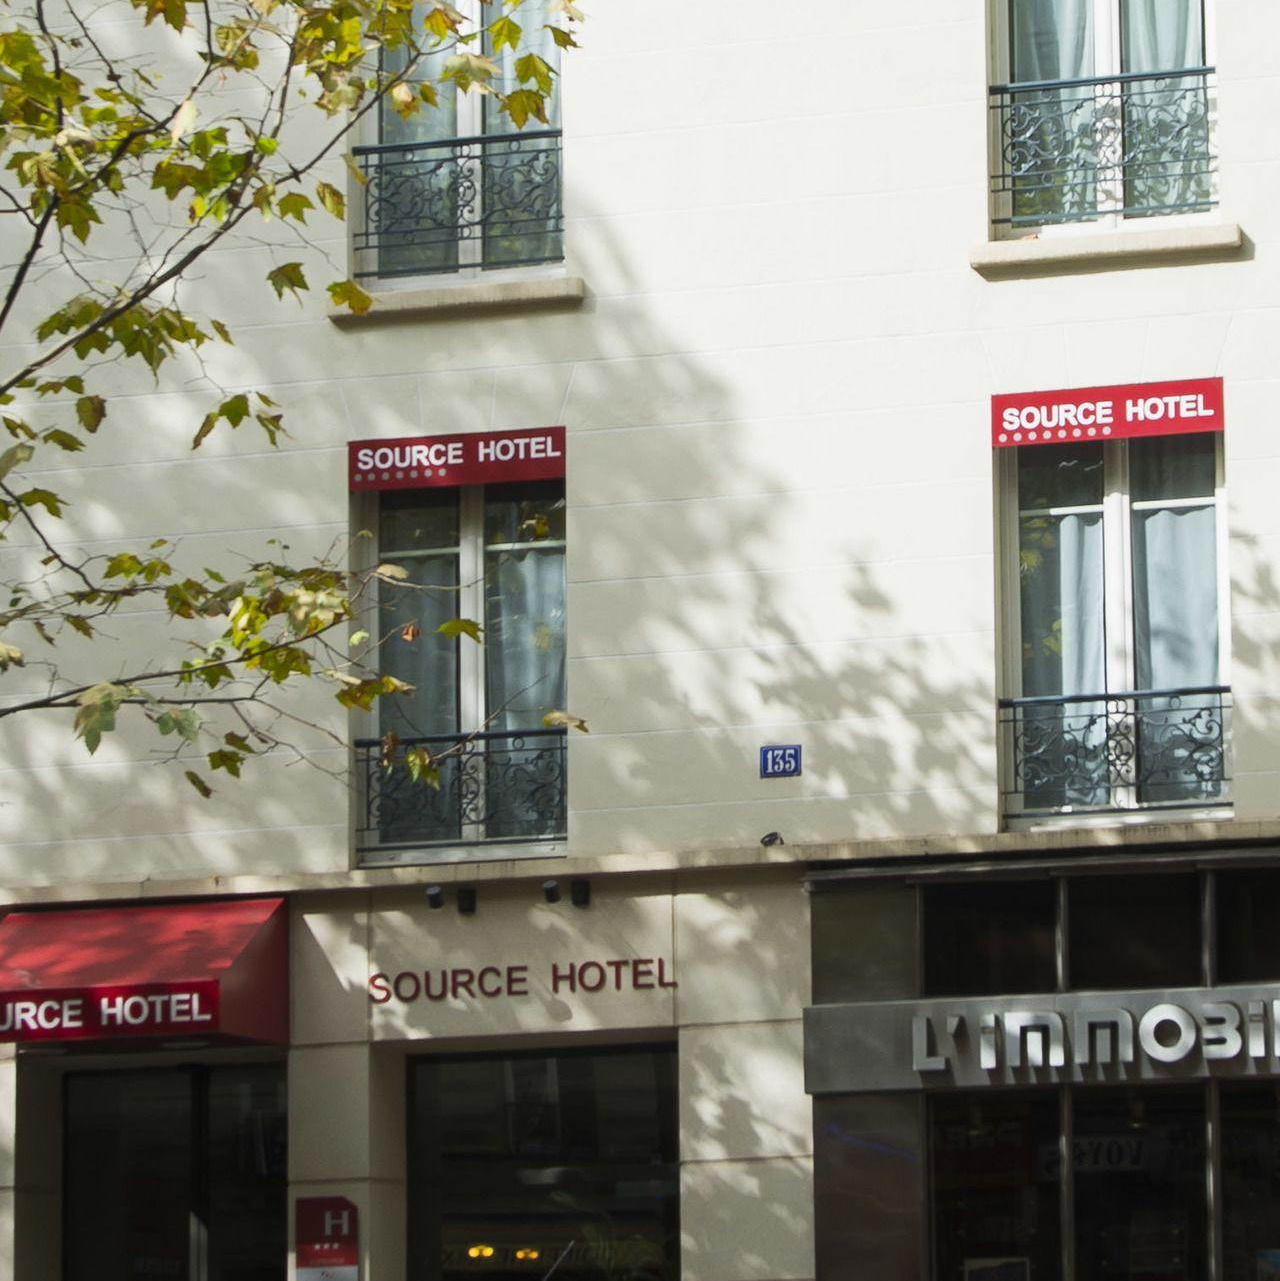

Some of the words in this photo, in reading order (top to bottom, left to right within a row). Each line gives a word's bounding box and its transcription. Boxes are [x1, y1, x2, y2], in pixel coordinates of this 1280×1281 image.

[1002, 401, 1114, 431] SOURCE
[1125, 394, 1215, 422] HOTEL
[357, 442, 464, 470] SOURCE
[478, 436, 562, 462] HOTEL
[766, 749, 796, 773] 135
[368, 965, 529, 1005] SOURCE
[551, 957, 679, 994] HOTEL
[100, 992, 212, 1026] HOTEL
[324, 1210, 350, 1236] H
